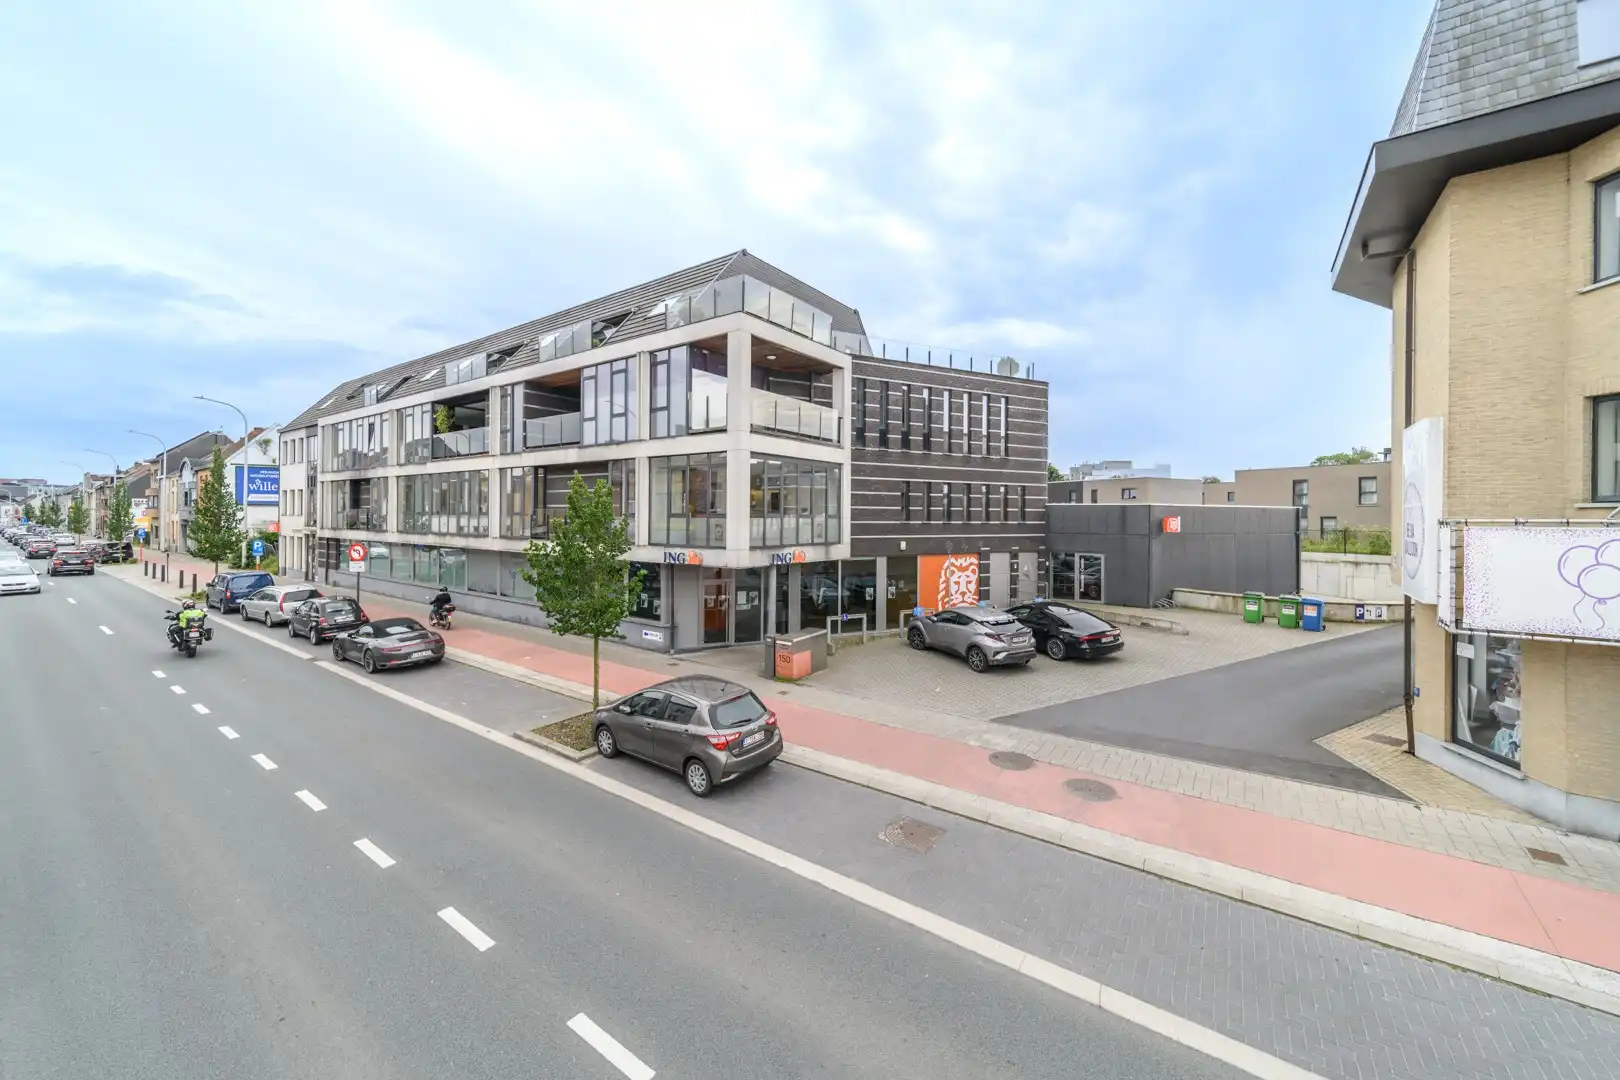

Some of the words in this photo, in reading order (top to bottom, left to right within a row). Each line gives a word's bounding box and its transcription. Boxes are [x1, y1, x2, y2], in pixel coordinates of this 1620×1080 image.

[254, 541, 262, 549] P
[663, 551, 685, 563] ING
[772, 553, 791, 564] ING
[1356, 607, 1364, 616] P
[778, 654, 791, 664] 150
